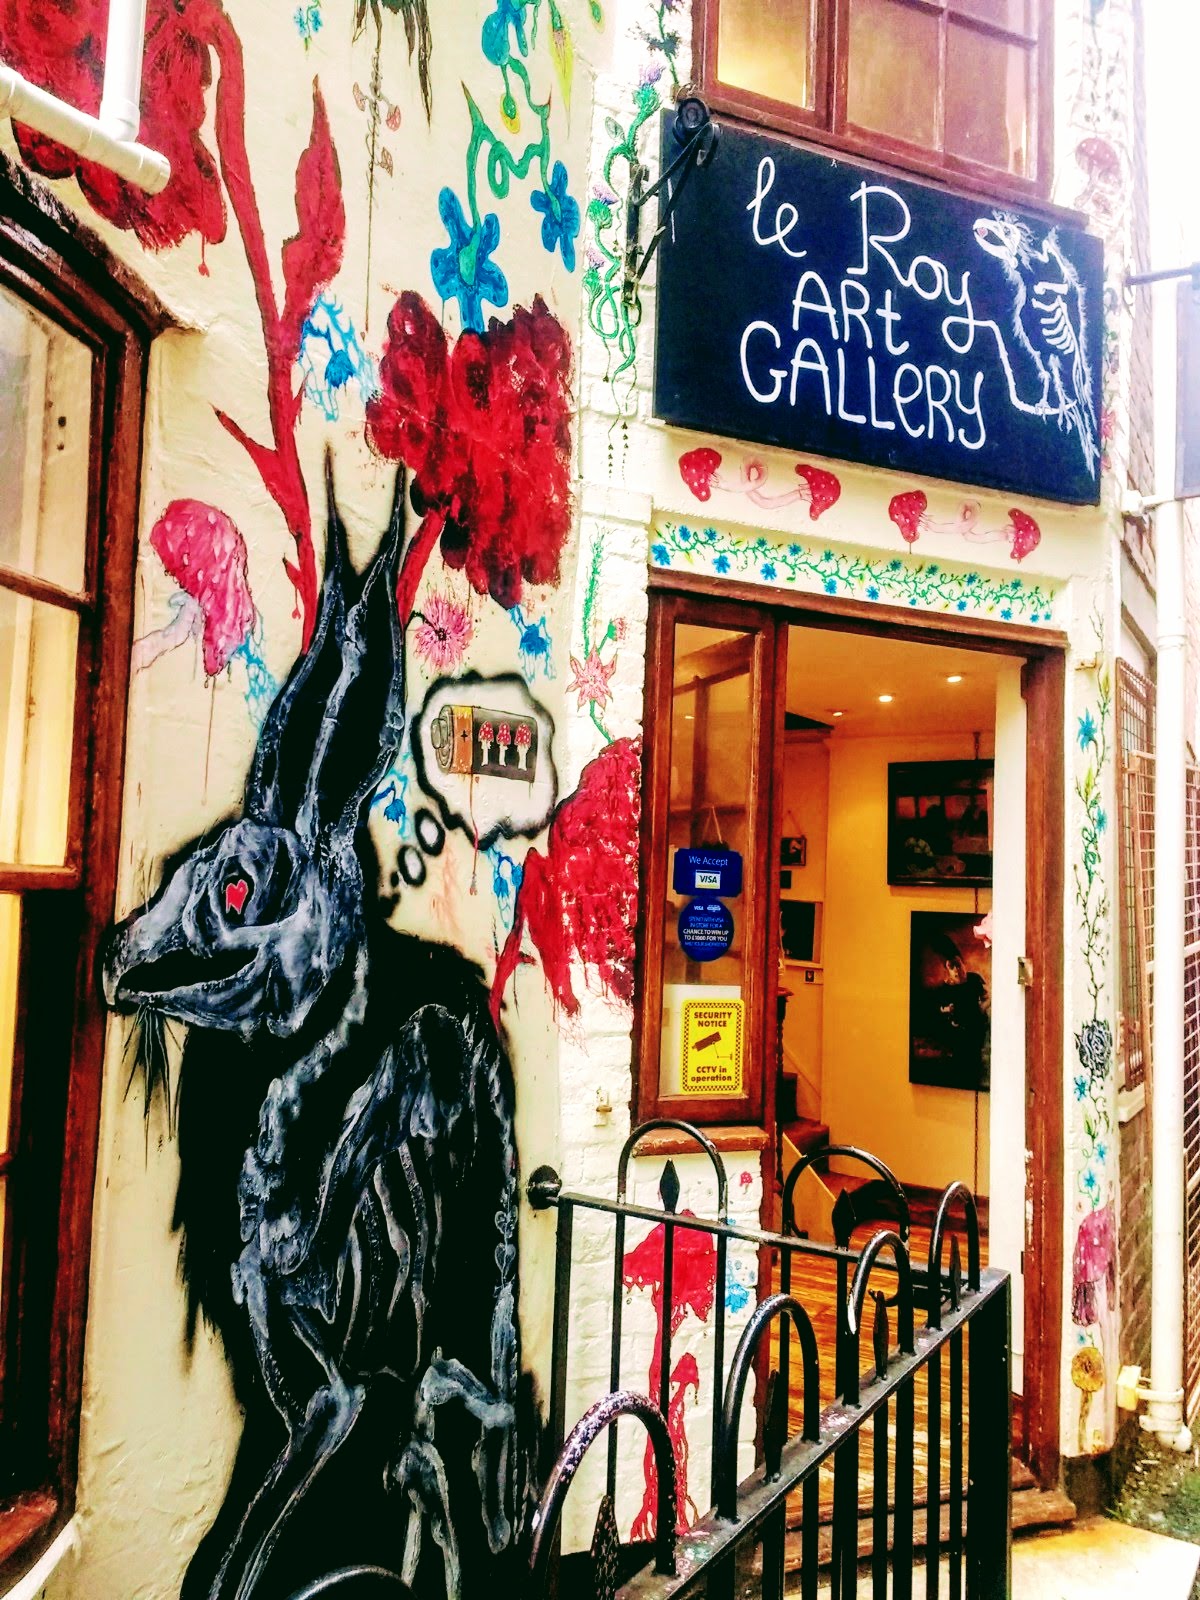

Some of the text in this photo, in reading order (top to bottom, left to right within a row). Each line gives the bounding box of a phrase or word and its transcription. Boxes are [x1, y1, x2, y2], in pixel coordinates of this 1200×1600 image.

[746, 156, 994, 354] le Roy
[689, 856, 728, 867] We Accept
[699, 875, 717, 883] VISA
